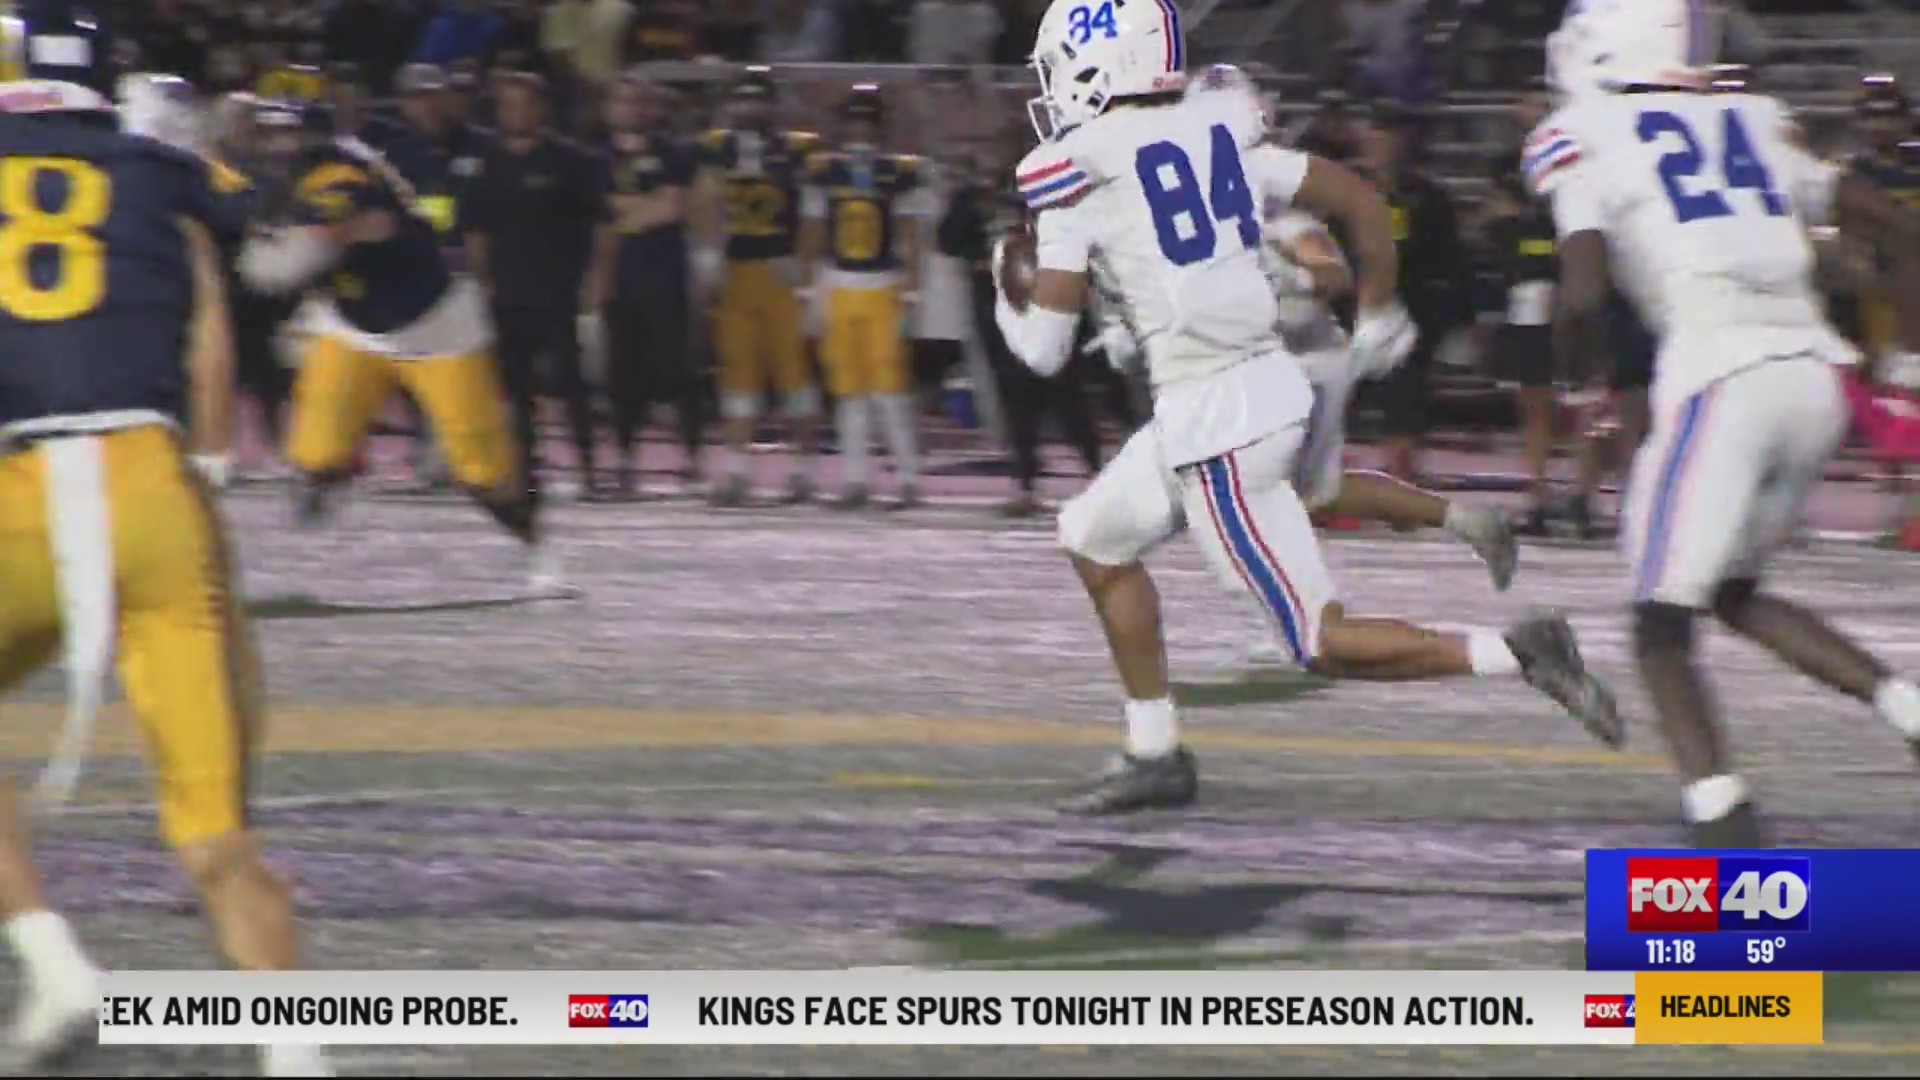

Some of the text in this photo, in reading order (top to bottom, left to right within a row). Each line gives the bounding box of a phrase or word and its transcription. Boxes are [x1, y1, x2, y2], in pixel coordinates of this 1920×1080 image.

[1068, 1, 1119, 44] 84
[1135, 123, 1261, 265] 84
[1636, 108, 1787, 223] 24
